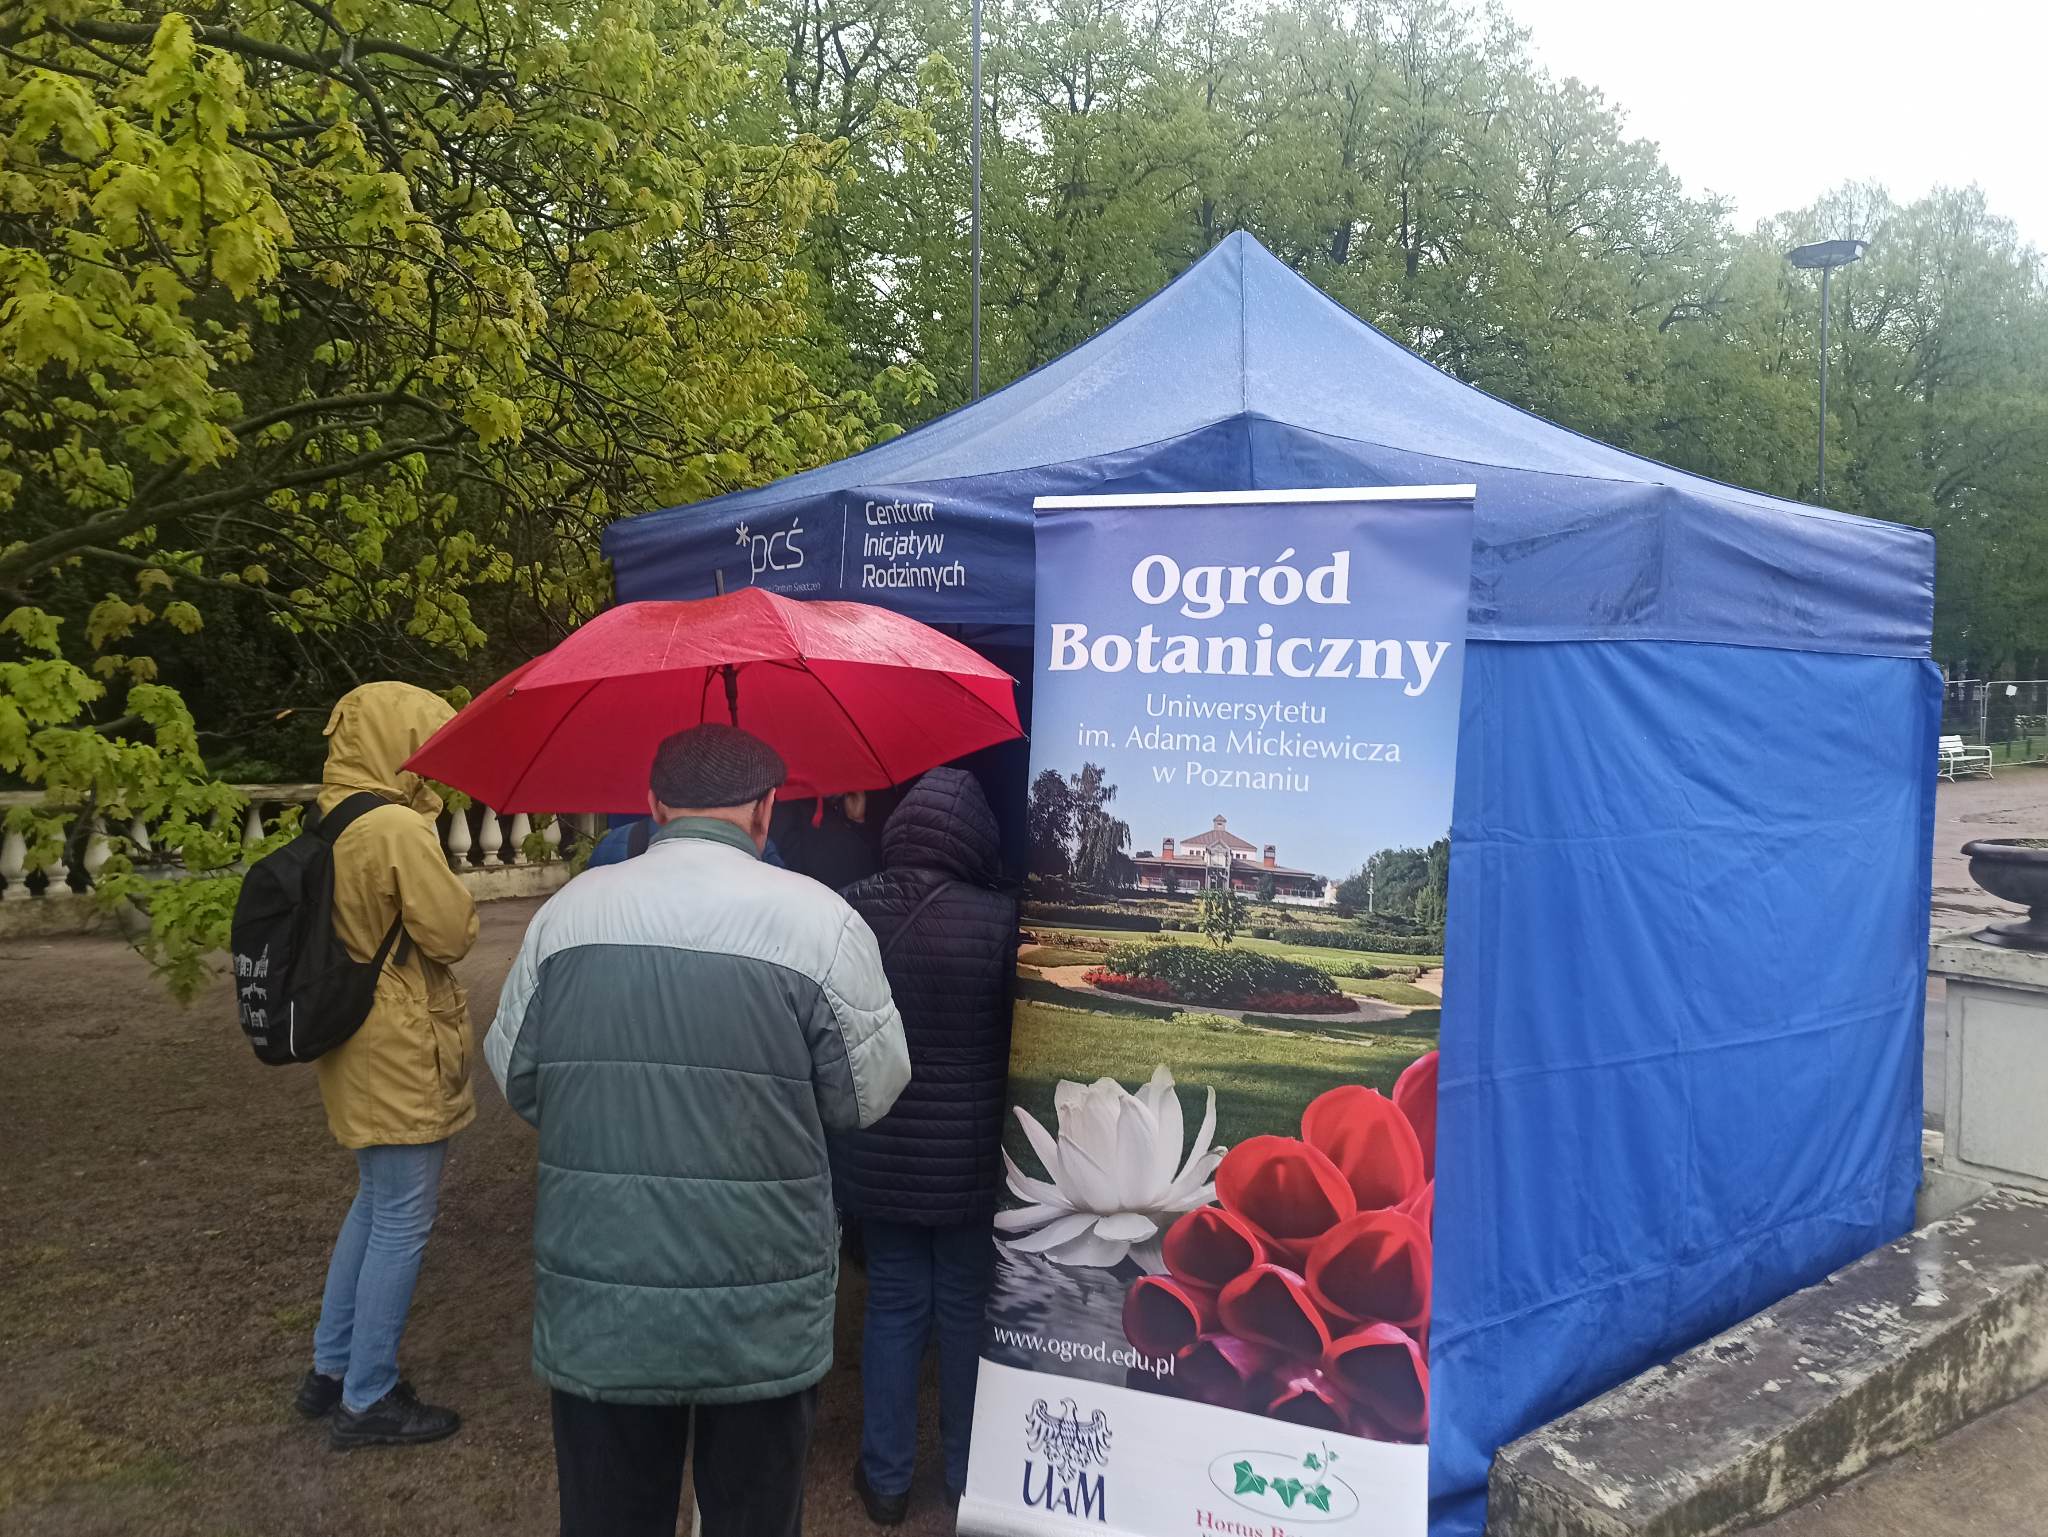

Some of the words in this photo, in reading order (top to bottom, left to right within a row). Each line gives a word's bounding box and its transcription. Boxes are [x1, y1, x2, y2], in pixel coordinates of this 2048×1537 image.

[866, 500, 934, 526] Centrum
[863, 530, 945, 561] Inicjatyw
[862, 560, 965, 592] Rodzinnych
[1131, 547, 1351, 620] Ogród
[1047, 623, 1452, 697] Botaniczny
[1146, 693, 1327, 728] Uniwersytetu
[1077, 723, 1116, 748] im.
[1125, 725, 1217, 753] Adama
[1226, 730, 1401, 763] Mickiewicza
[1153, 765, 1176, 784] w
[1186, 762, 1310, 792] Poznaniu
[993, 1326, 1176, 1380] www.ogrod.edu.pl
[1023, 1459, 1106, 1524] UAM
